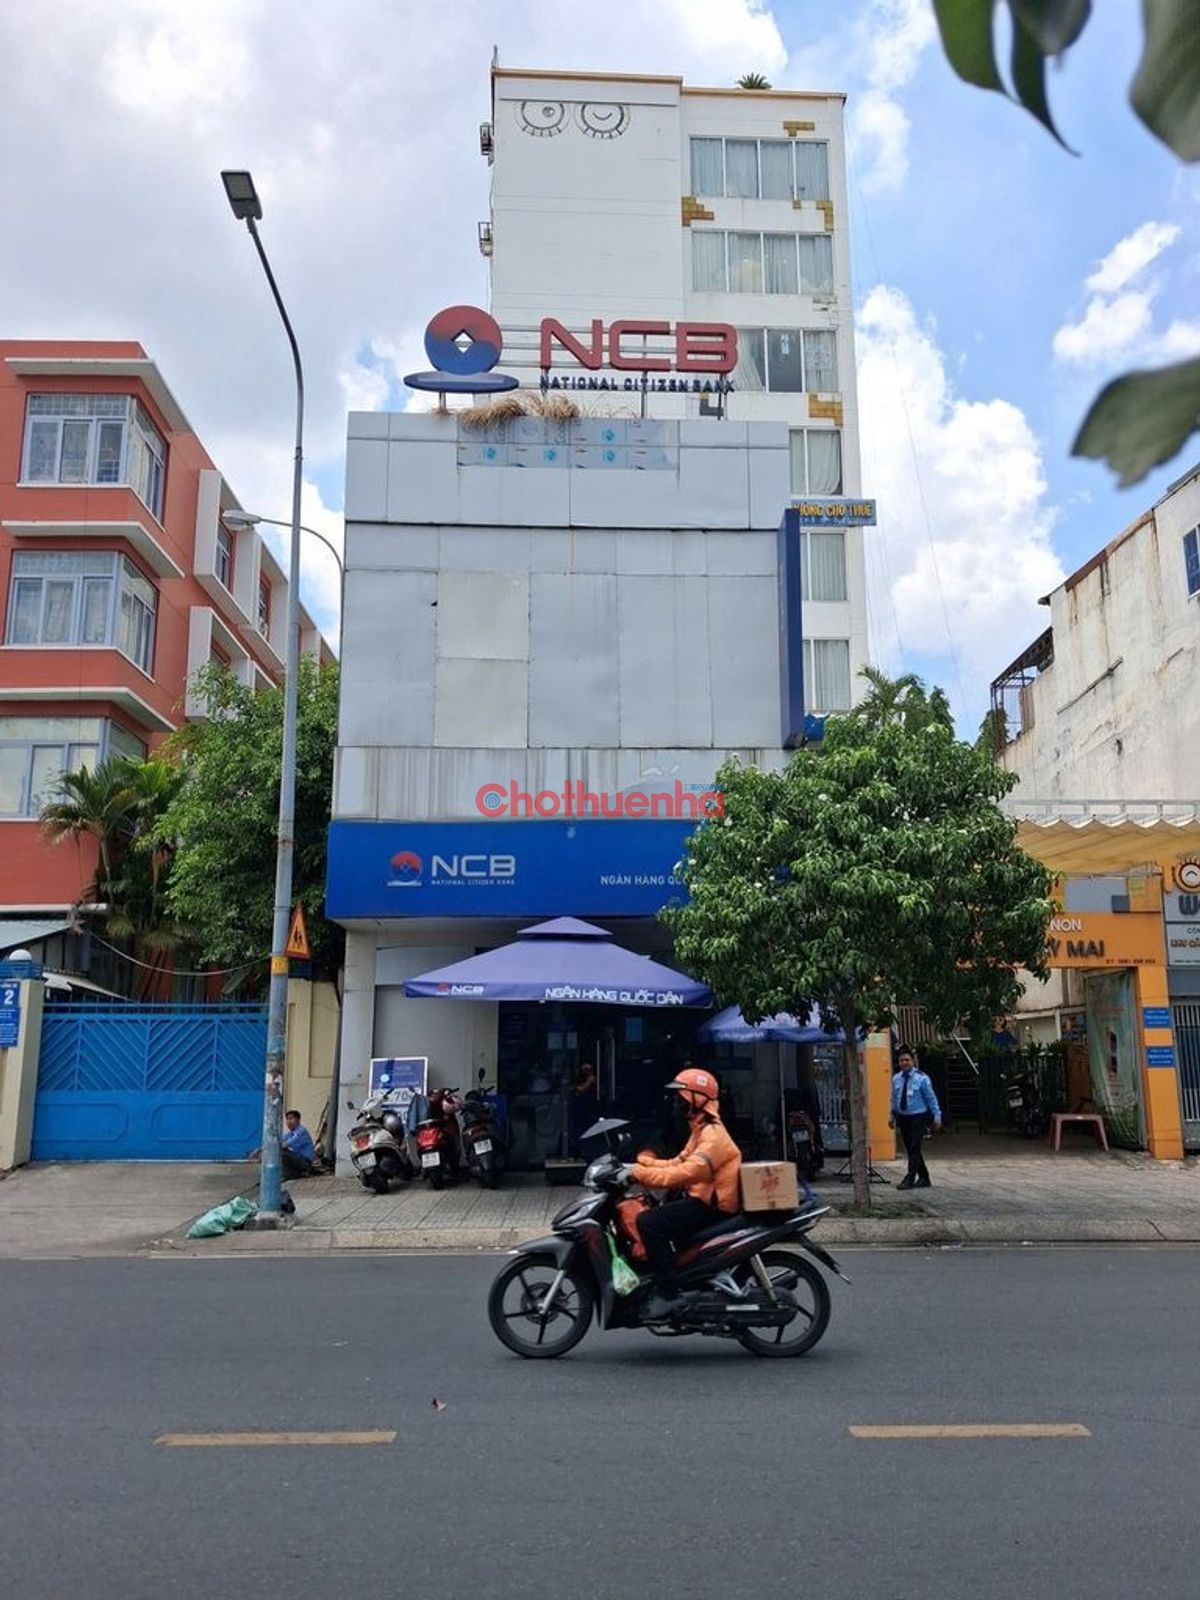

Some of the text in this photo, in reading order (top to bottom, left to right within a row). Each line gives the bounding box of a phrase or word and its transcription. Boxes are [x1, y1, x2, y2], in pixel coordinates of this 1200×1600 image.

[540, 317, 739, 374] NCB
[540, 376, 736, 394] NATIONAL CITIZEN BANK
[431, 854, 516, 877] NCB
[1050, 919, 1082, 931] NON
[1066, 940, 1105, 958] MAI
[4, 989, 14, 1005] 2
[451, 985, 484, 996] NCB
[545, 985, 684, 1005] NGÂN HÀNG QUỐC DÂN
